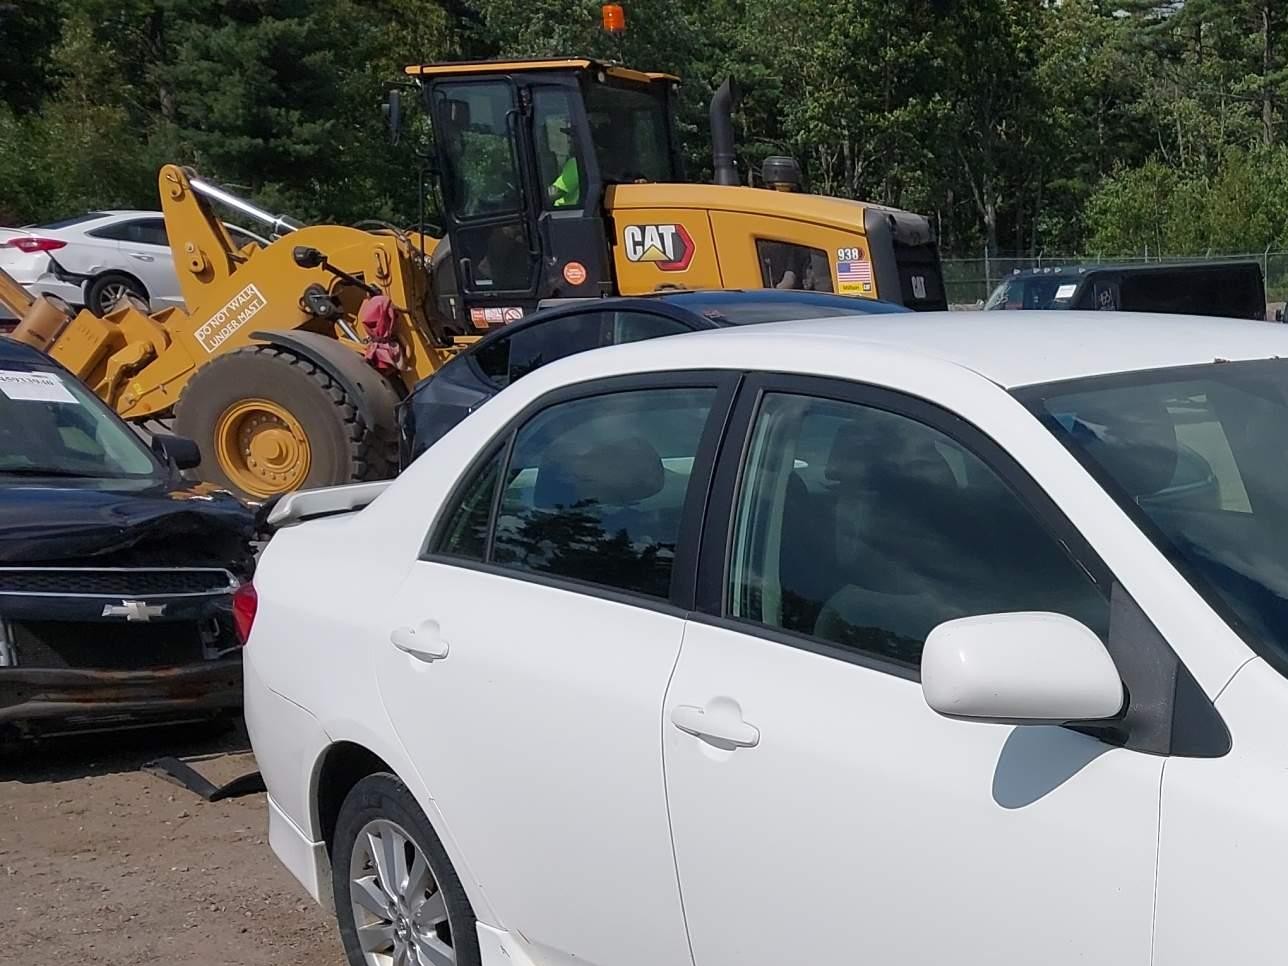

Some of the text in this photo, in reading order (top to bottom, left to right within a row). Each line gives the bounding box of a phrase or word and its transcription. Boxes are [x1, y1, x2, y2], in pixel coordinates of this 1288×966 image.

[624, 225, 676, 261] CAT
[837, 248, 859, 260] 938
[197, 286, 255, 340] DO NOT WALK
[210, 299, 260, 347] UNDER MAST
